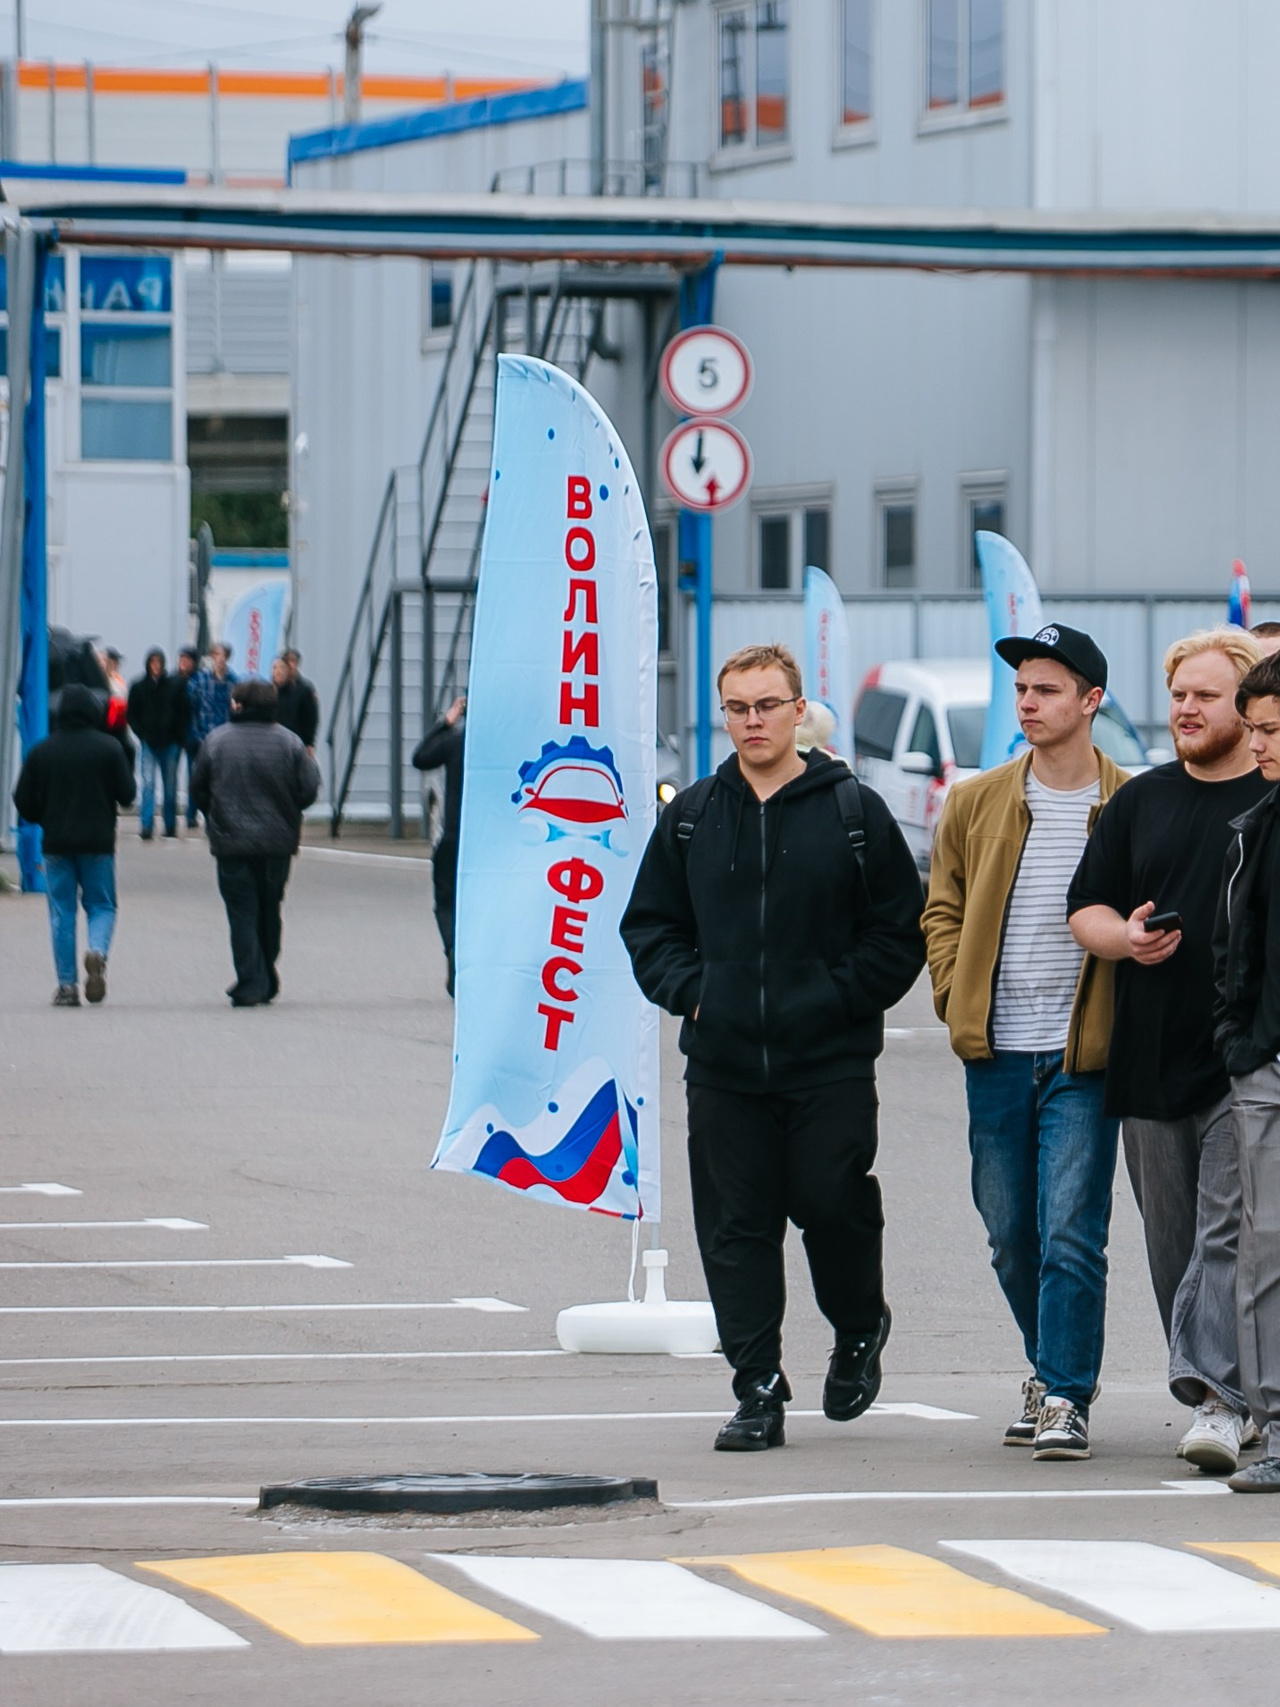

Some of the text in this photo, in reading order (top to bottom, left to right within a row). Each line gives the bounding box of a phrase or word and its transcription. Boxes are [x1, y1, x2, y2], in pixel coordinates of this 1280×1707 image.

[699, 357, 718, 389] 5
[559, 475, 599, 727] ВОЛИН
[538, 857, 604, 1052] ФЕСТ
